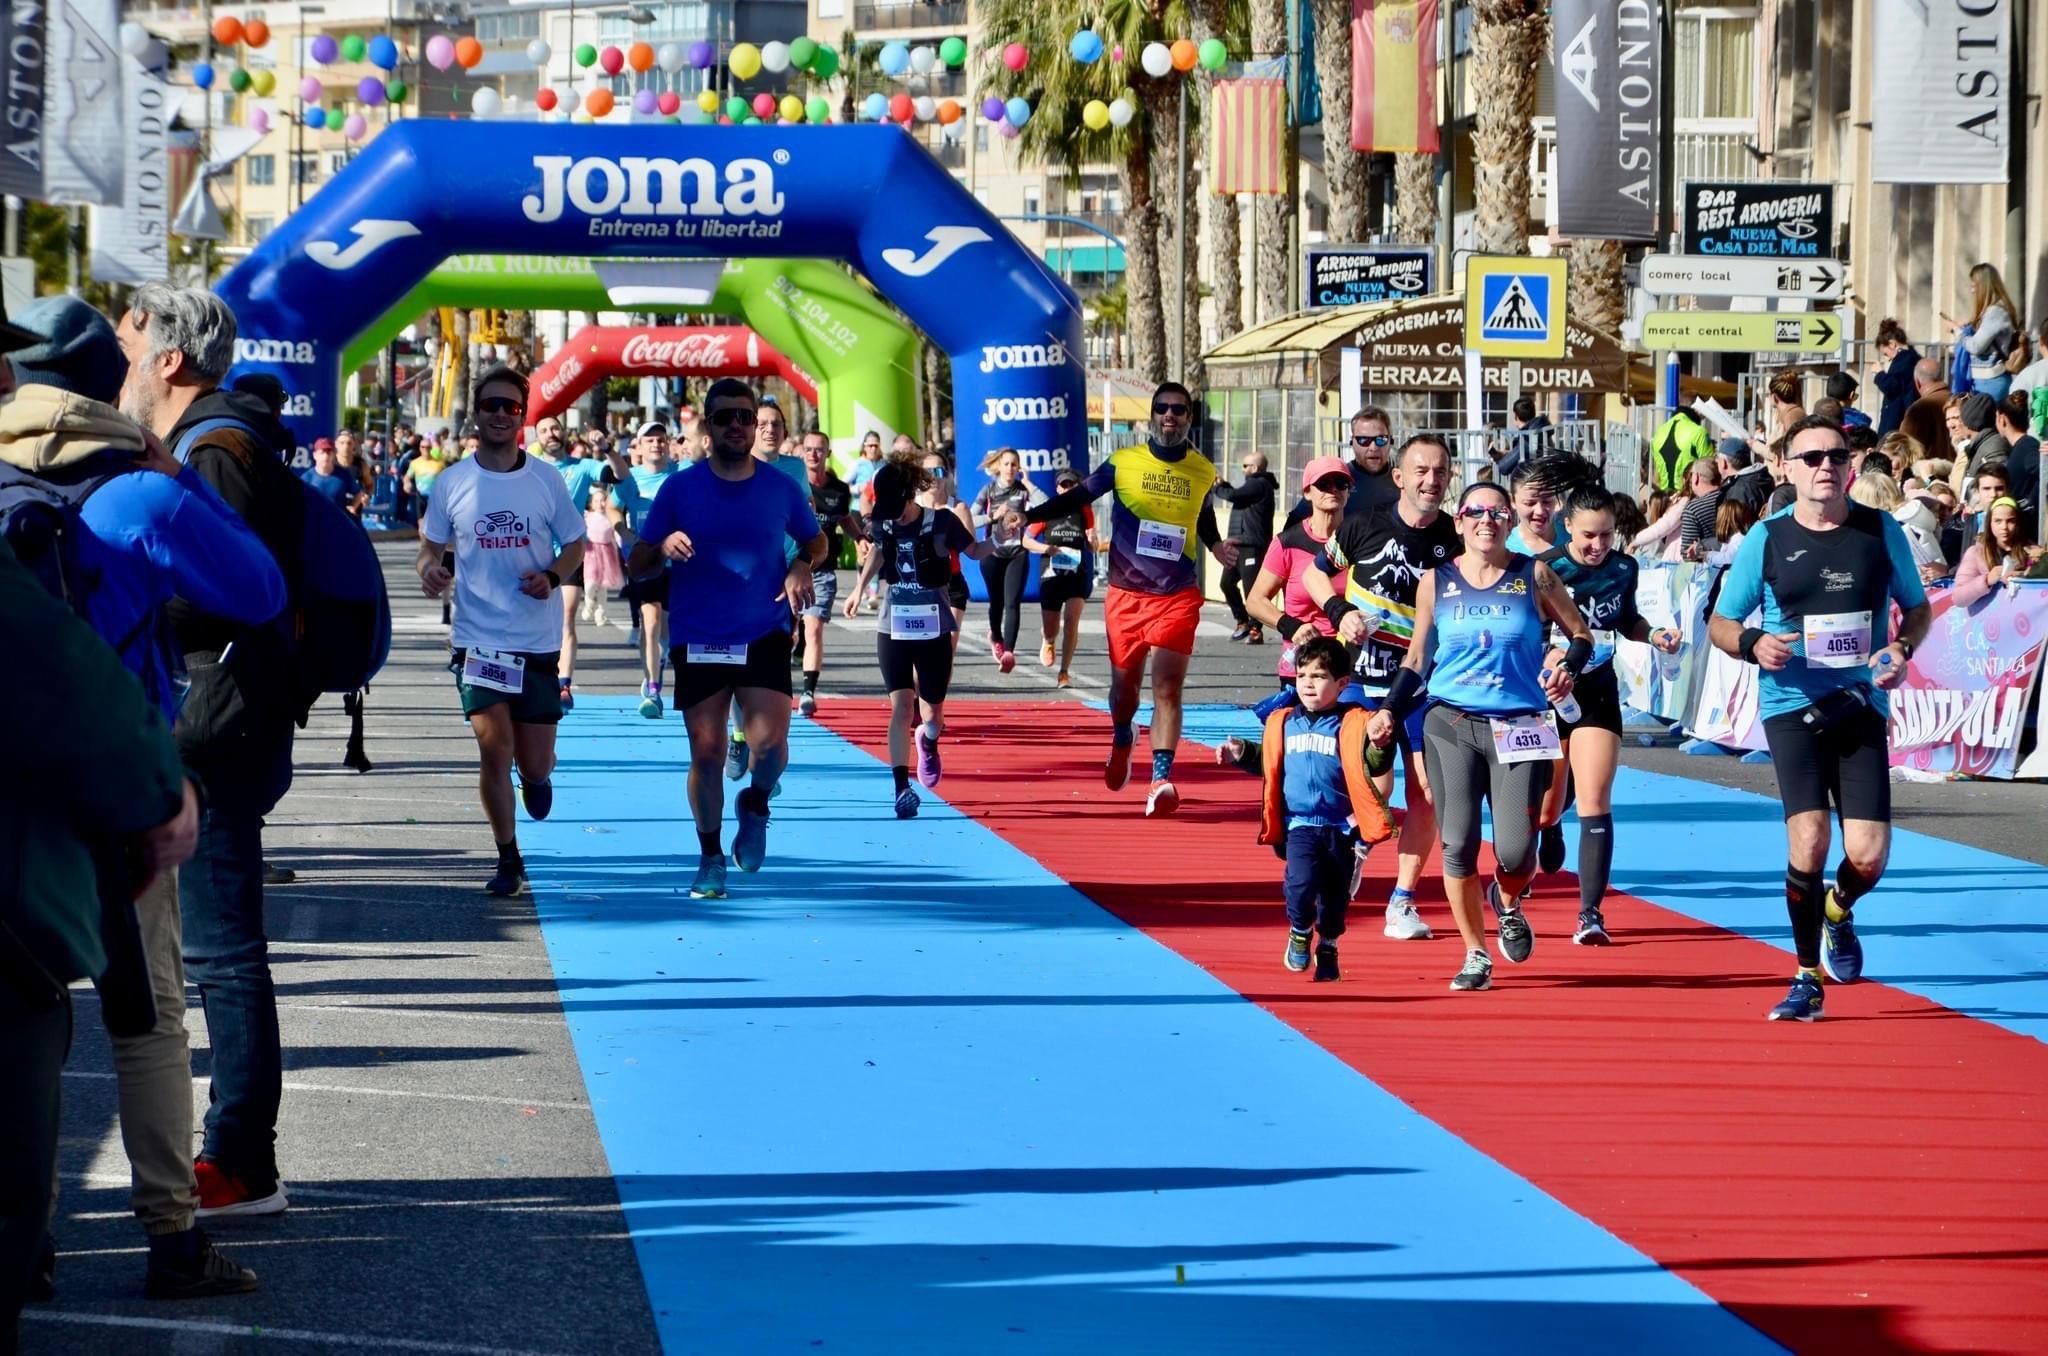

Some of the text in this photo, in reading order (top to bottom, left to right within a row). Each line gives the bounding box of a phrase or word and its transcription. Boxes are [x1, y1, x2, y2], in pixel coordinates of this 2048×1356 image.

[1617, 0, 1653, 209] ASTOND
[1697, 190, 1736, 208] BAR
[1697, 193, 1822, 232] REST. ARROCERIA
[588, 218, 782, 238] Entrena tu libertad
[1730, 228, 1777, 241] NUEVA
[1316, 255, 1377, 273] ARROCERIA
[1317, 268, 1360, 286] TAPERIA
[1368, 258, 1424, 278] FREIDURIA
[1648, 270, 1732, 281] comerç local
[1344, 282, 1386, 293] NUEVA
[799, 297, 831, 326] 104
[828, 319, 859, 348] 102
[1648, 325, 1743, 336] mercat central
[1373, 343, 1432, 357] NUEVA
[1142, 472, 1191, 488] SAN SILVESTRE
[1142, 481, 1171, 493] MURCIA
[1468, 605, 1512, 617] COYP
[905, 620, 926, 629] 5155
[1827, 637, 1859, 652] 4055
[1286, 732, 1337, 756] PUMA
[1515, 733, 1542, 747] 4313
